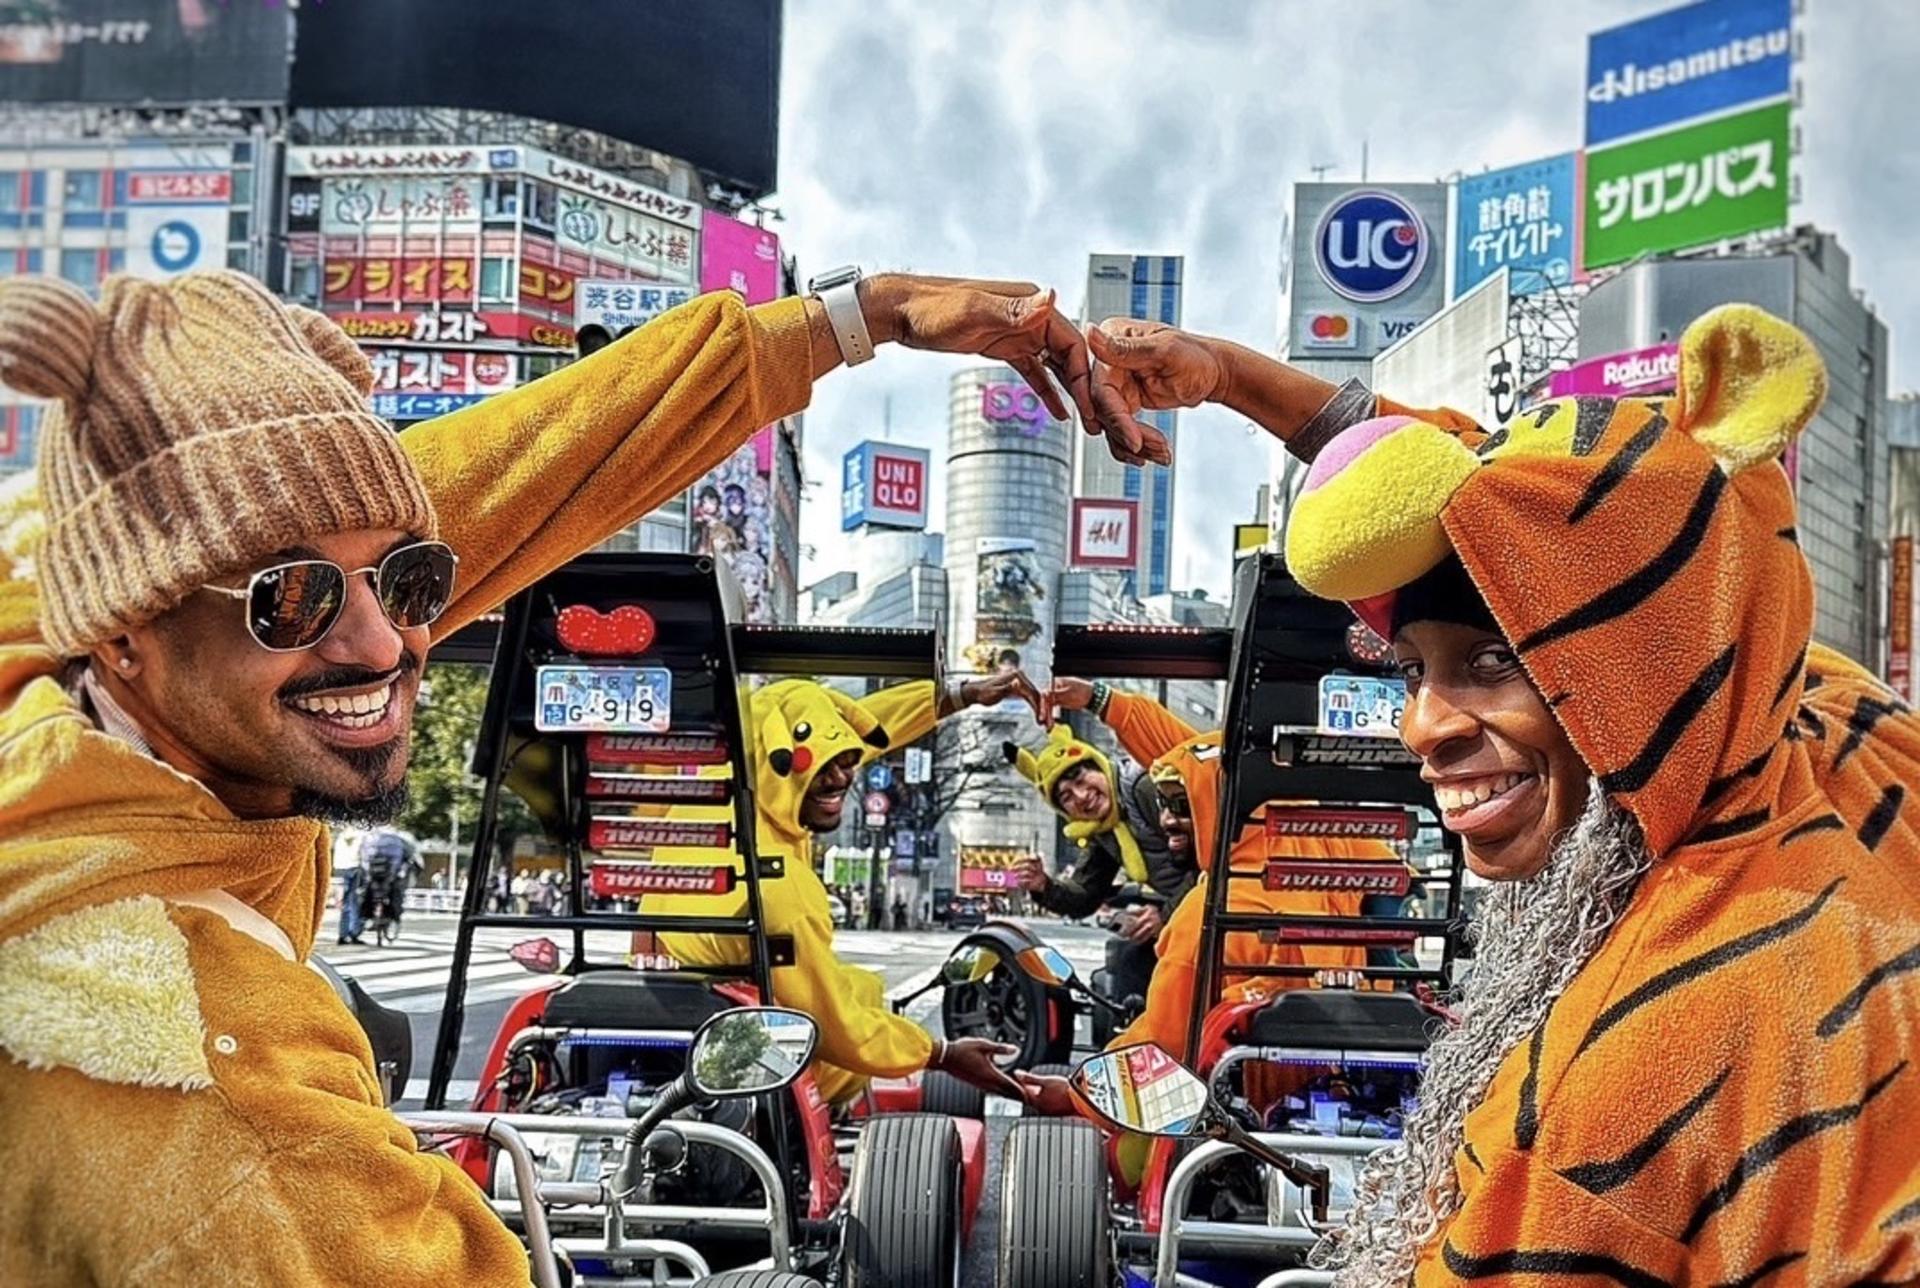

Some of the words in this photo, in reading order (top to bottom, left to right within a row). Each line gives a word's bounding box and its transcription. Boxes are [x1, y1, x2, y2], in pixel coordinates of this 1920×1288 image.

[1589, 28, 1788, 103] Hisamitsu
[1595, 139, 1777, 230] サロンパス
[291, 193, 321, 217] 9F
[1327, 219, 1415, 270] UC
[413, 311, 487, 342] ガスト
[1382, 320, 1424, 340] VIS
[373, 350, 460, 391] ガスト
[371, 395, 473, 416] 話イーオ
[878, 460, 915, 485] UNI
[877, 483, 917, 506] QLO
[603, 829, 718, 845] RENTHAL
[1277, 822, 1399, 836] RENTHAL
[603, 873, 716, 890] RENTHAL
[1278, 874, 1398, 889] RENTHAL
